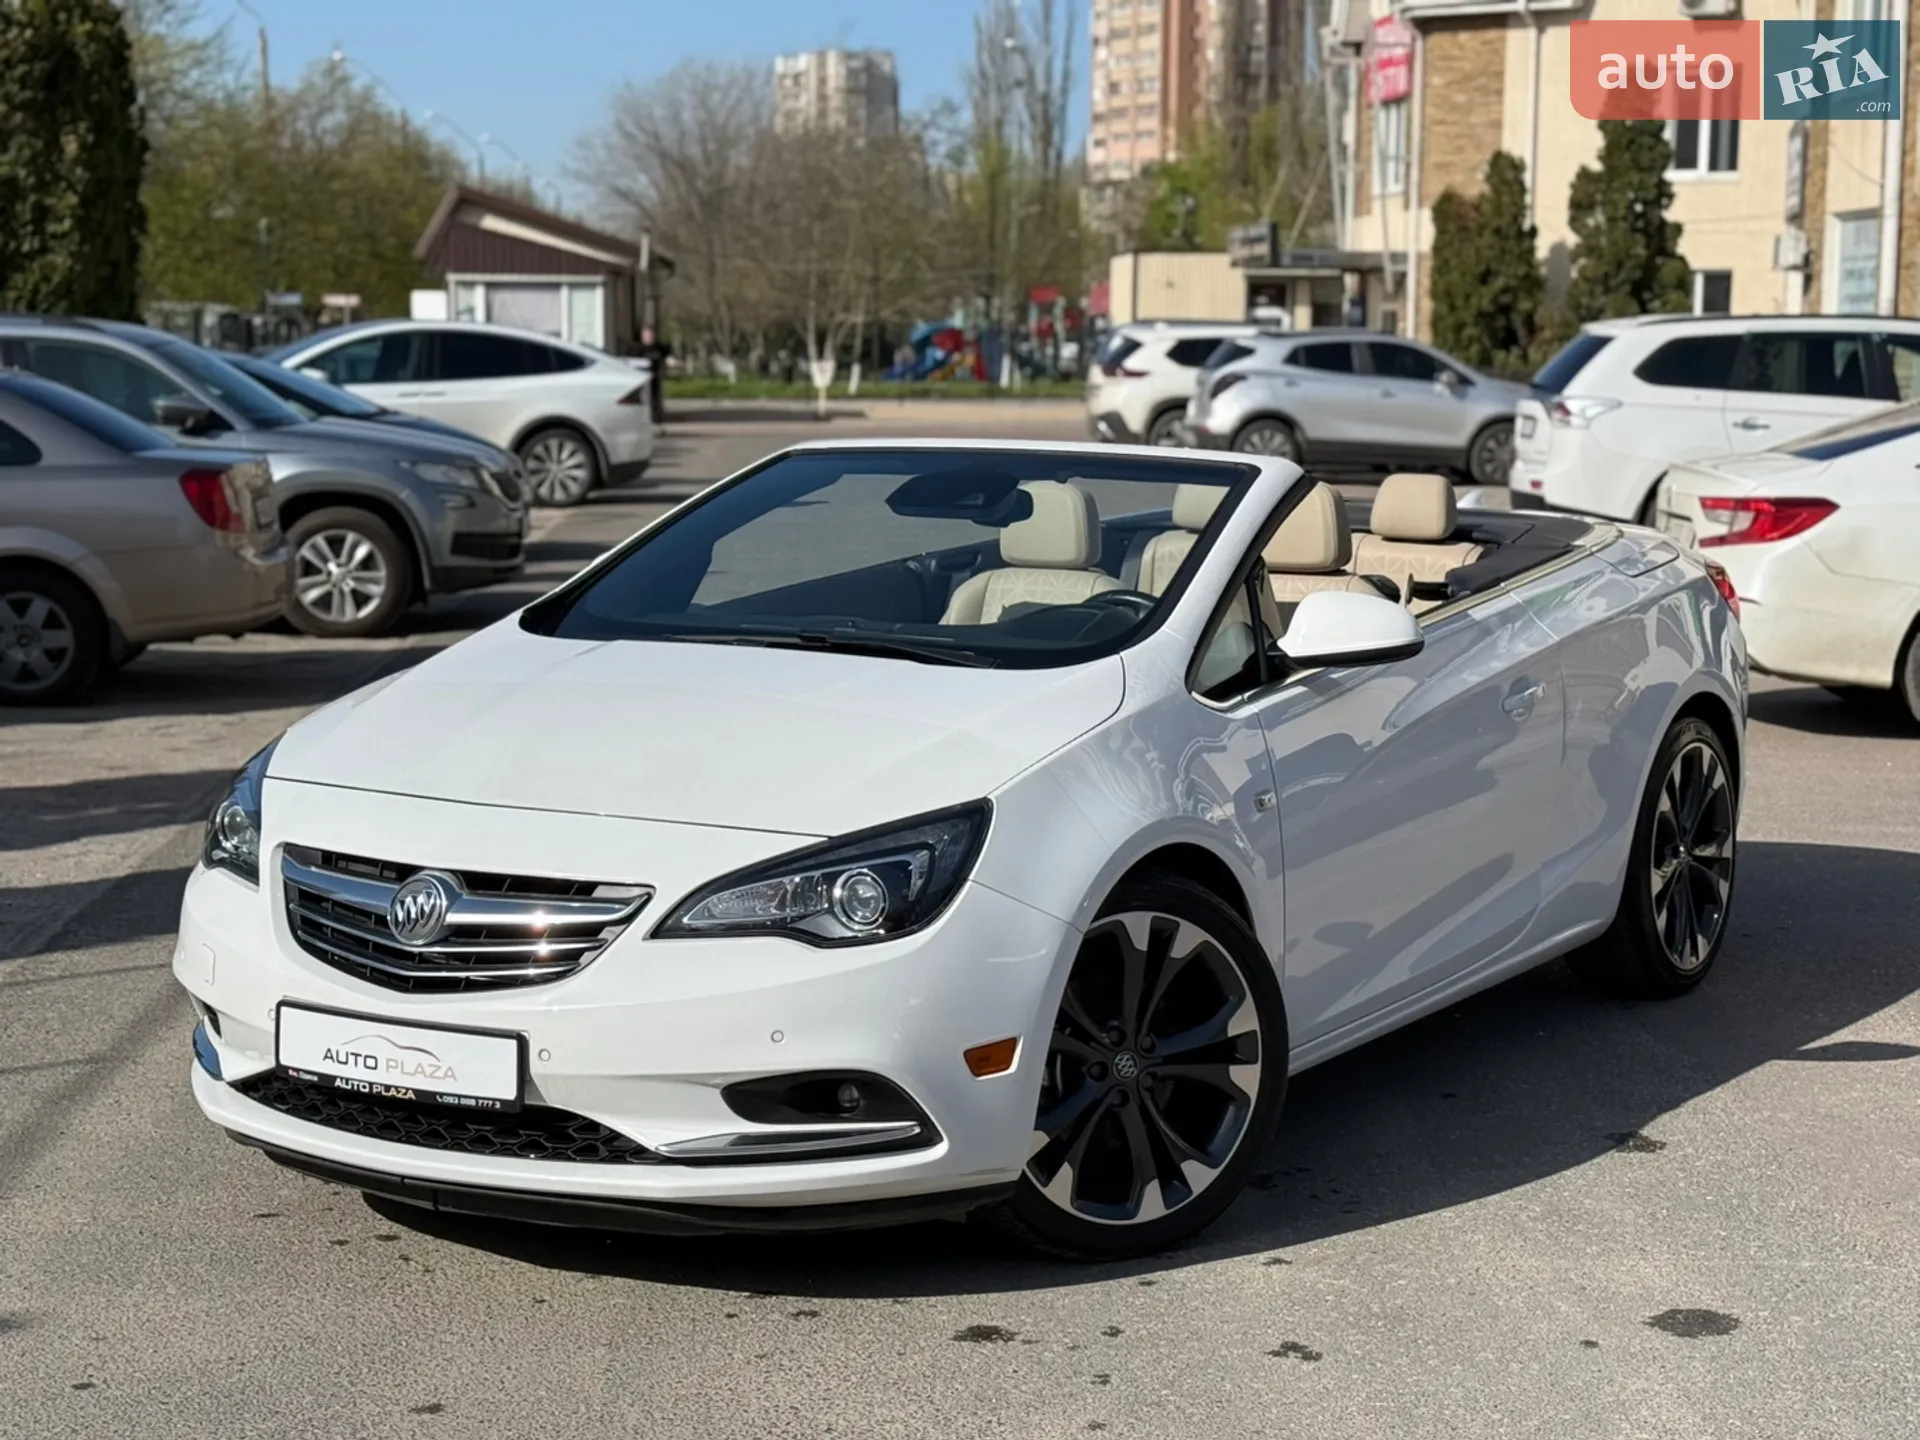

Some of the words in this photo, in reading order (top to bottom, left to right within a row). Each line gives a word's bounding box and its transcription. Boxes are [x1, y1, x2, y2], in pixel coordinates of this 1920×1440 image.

[322, 1047, 378, 1071] AUTO
[385, 1057, 458, 1082] PLAZA
[334, 1077, 369, 1093] AUTO
[372, 1084, 416, 1100] PLAZA
[477, 1099, 493, 1107] 777
